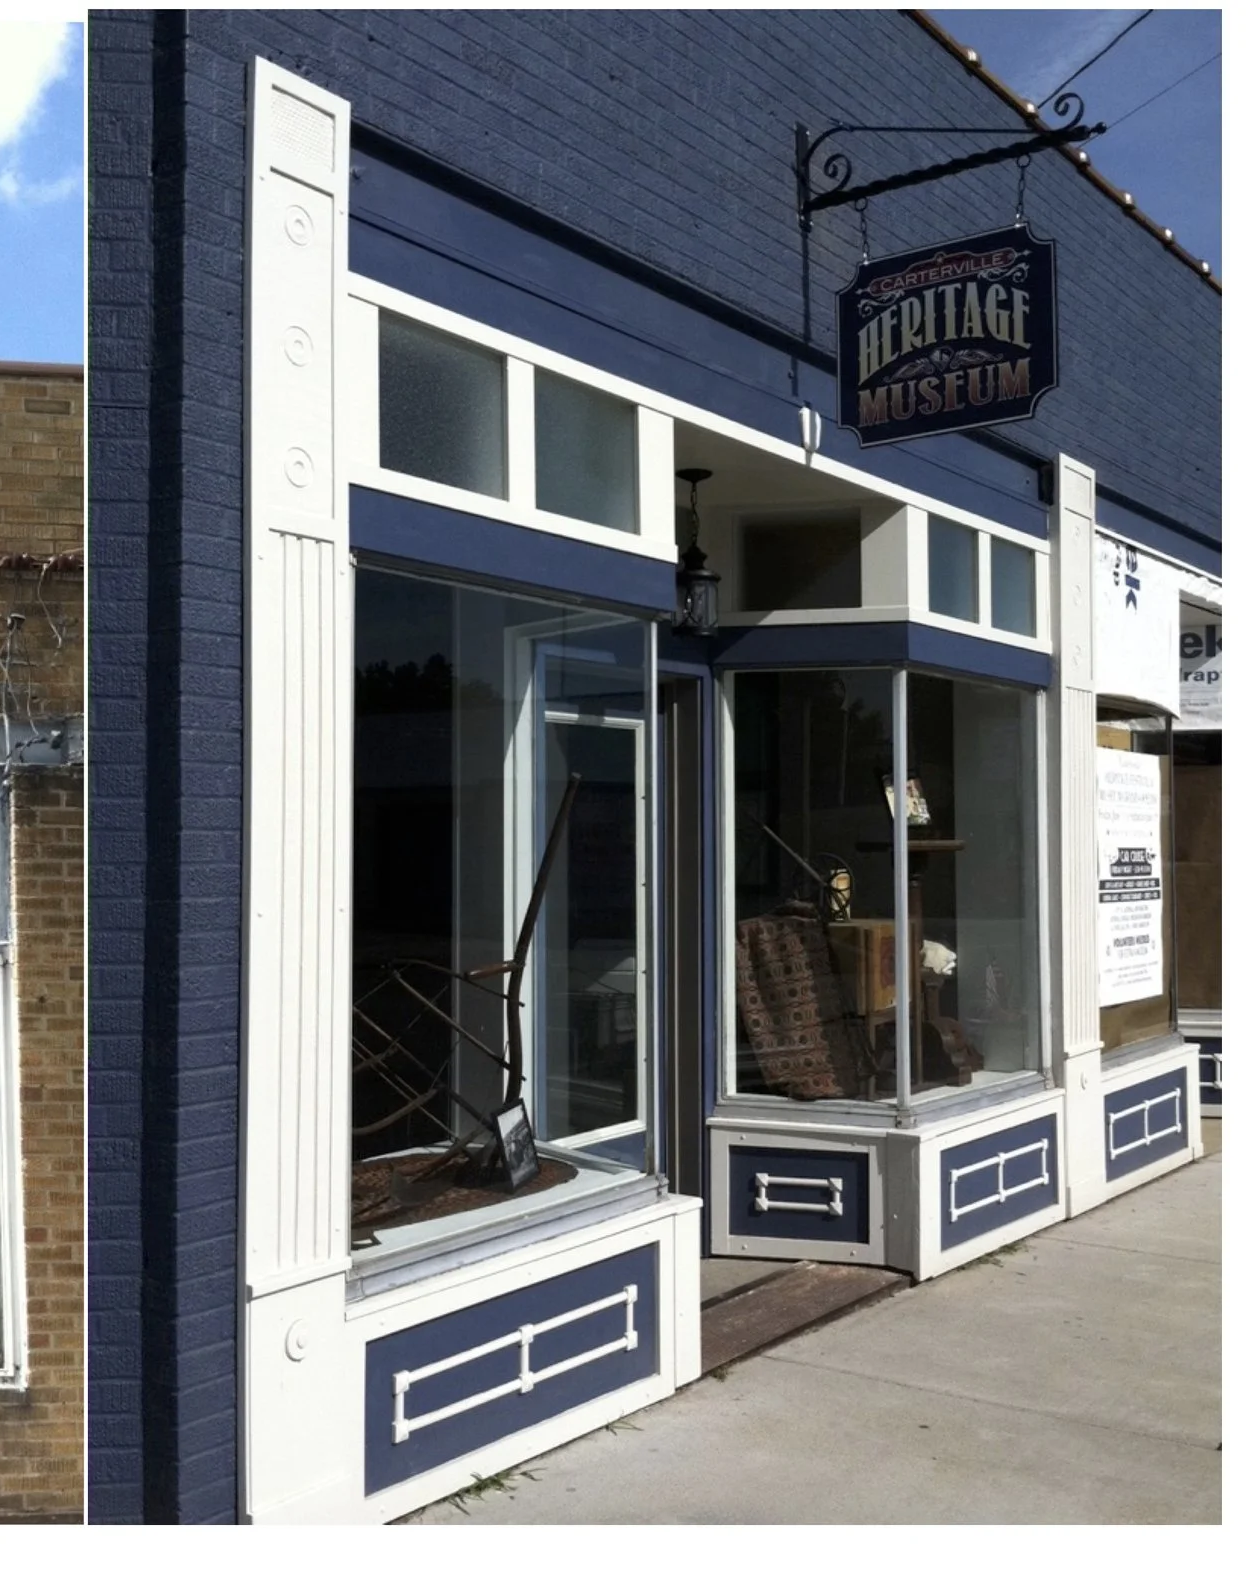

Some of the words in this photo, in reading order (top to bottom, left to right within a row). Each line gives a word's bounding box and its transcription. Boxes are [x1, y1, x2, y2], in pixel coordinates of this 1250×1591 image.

[879, 252, 1004, 292] CARTERVILLE
[858, 281, 1031, 386] HERITAGE
[858, 357, 1031, 427] MUSEUM
[1180, 668, 1222, 684] rap
